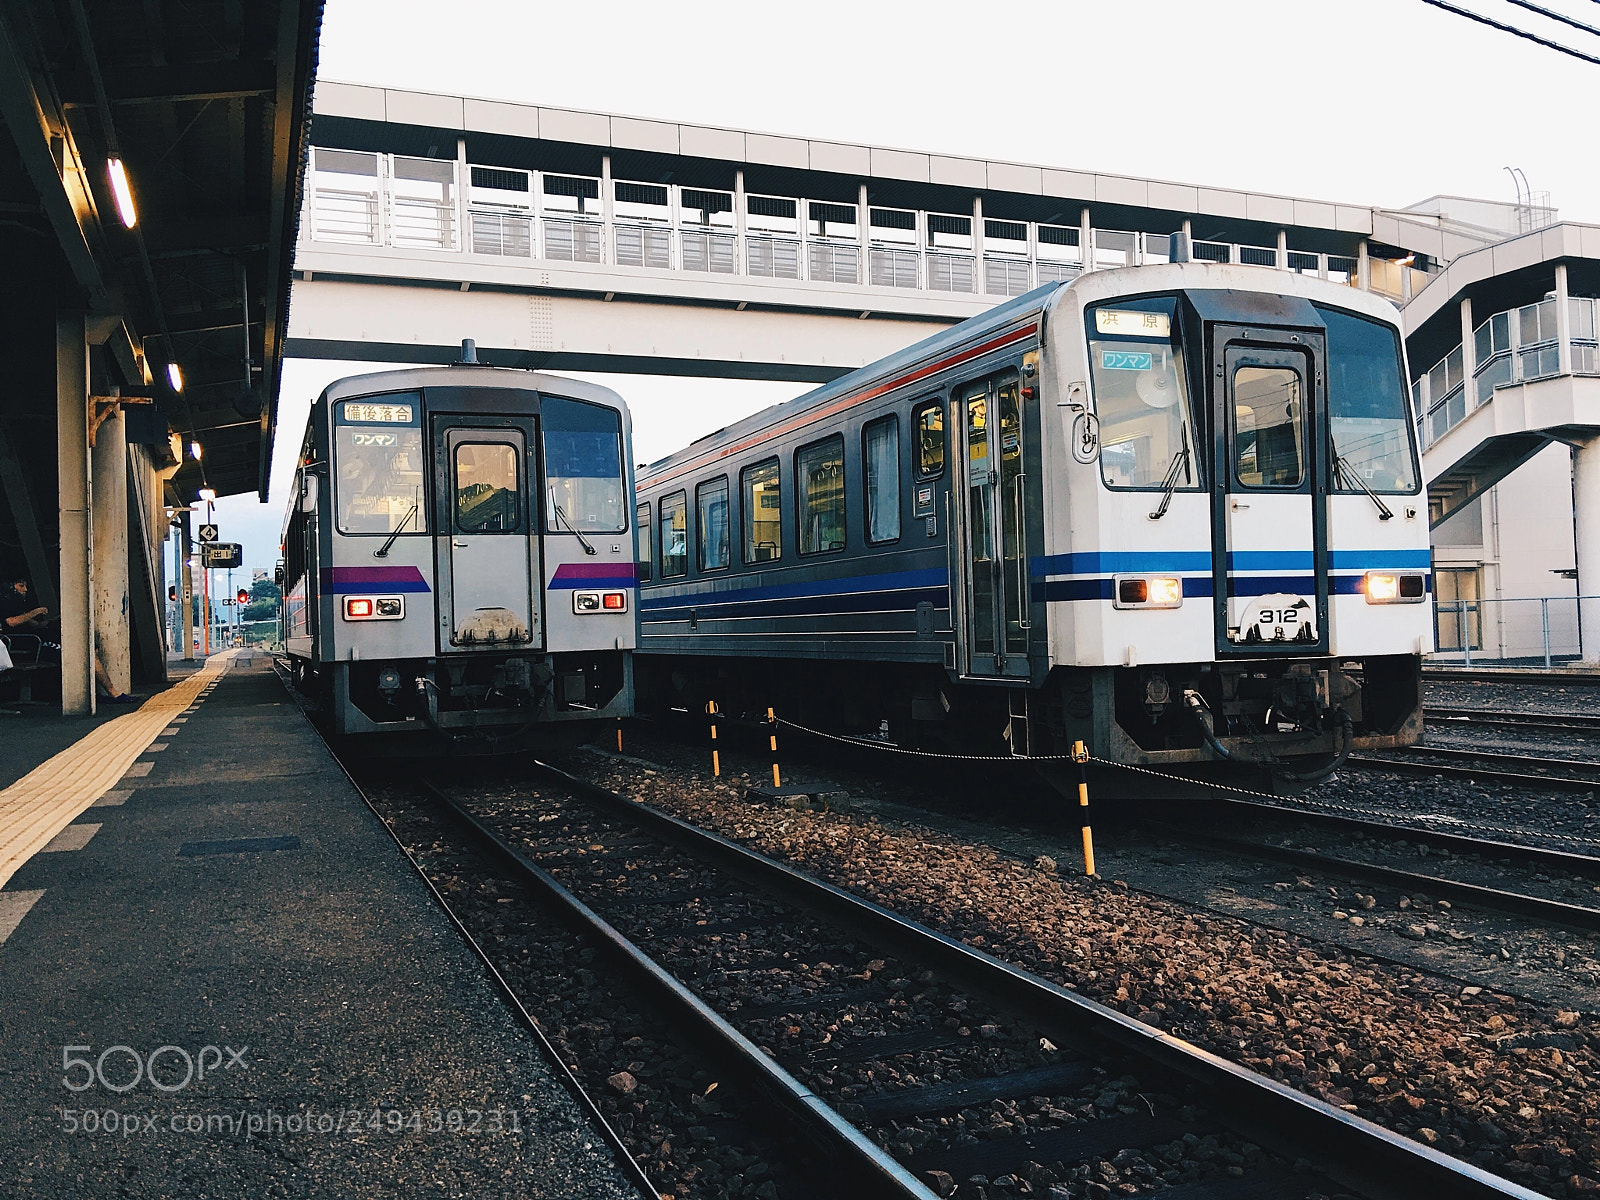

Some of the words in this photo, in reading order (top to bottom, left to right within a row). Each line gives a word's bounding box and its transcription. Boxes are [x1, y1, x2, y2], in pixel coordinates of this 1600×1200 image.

[1101, 310, 1159, 329] 浜原
[1104, 353, 1150, 368] ワンマン
[346, 405, 409, 422] 備後落合
[354, 434, 395, 446] ワンマン
[205, 527, 213, 538] 4
[1259, 609, 1298, 624] 312
